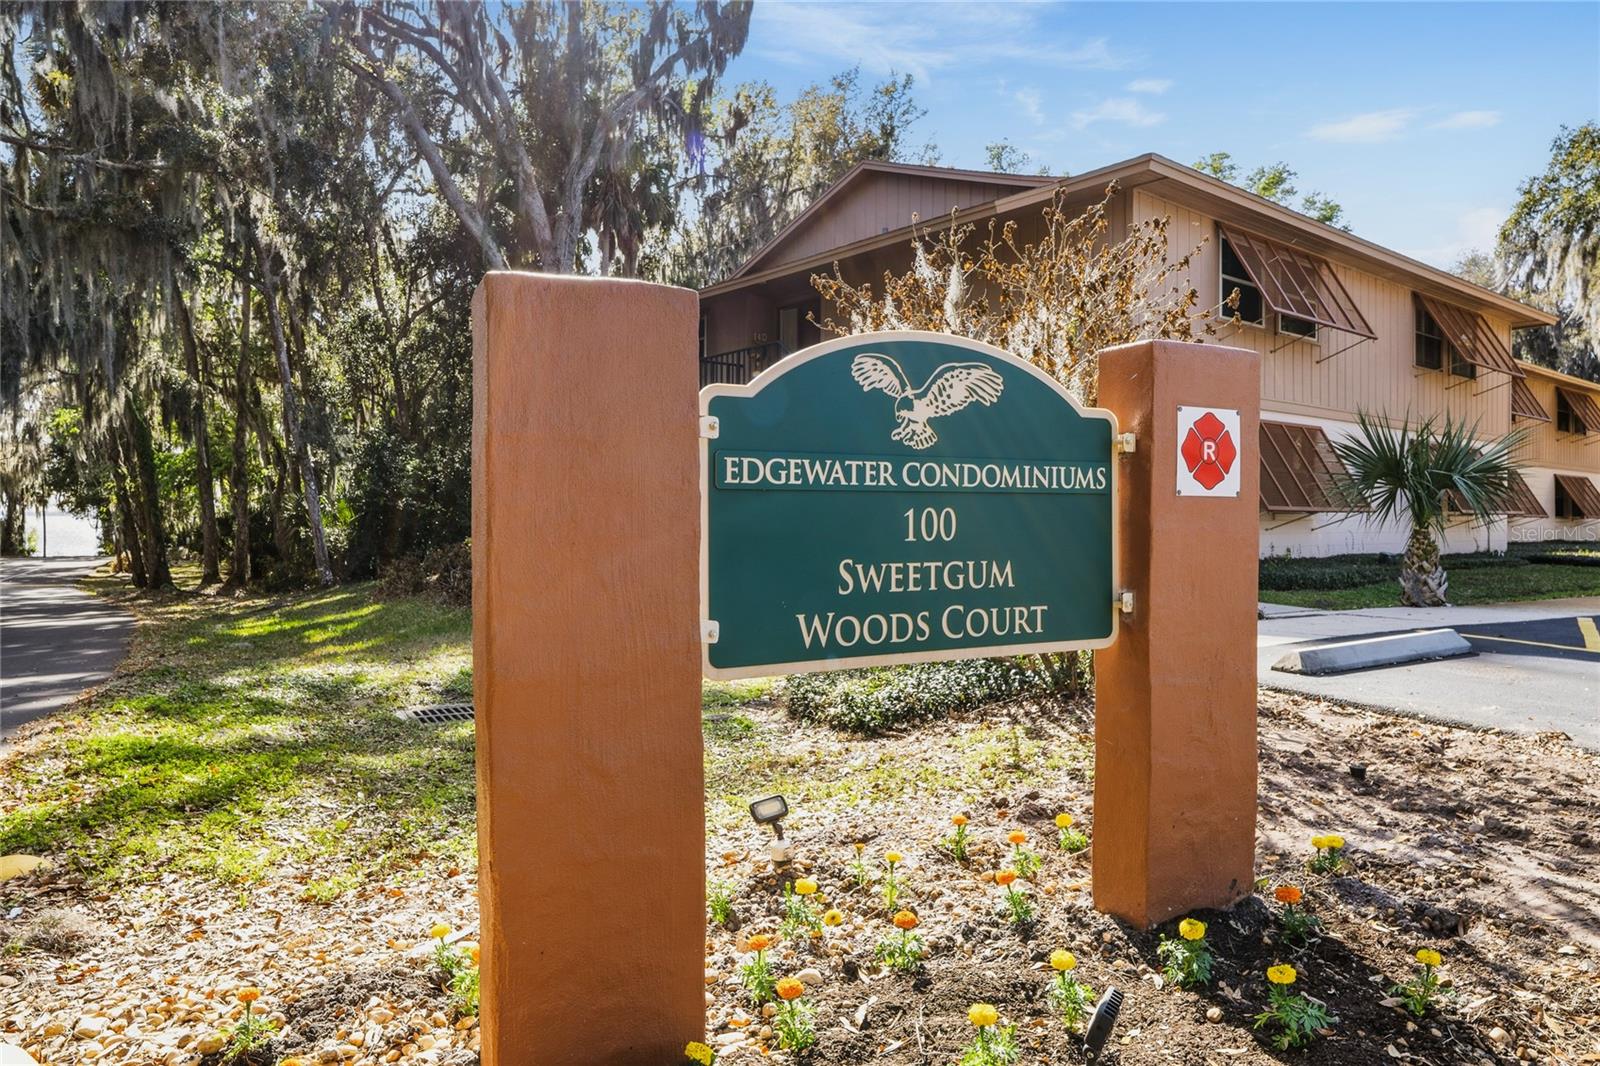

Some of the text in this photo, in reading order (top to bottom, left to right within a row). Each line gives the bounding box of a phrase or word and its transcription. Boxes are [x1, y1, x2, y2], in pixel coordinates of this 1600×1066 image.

[1203, 441, 1216, 461] R
[723, 456, 1106, 490] EDGEWATER CONDOMINIUMS
[904, 507, 957, 542] 100
